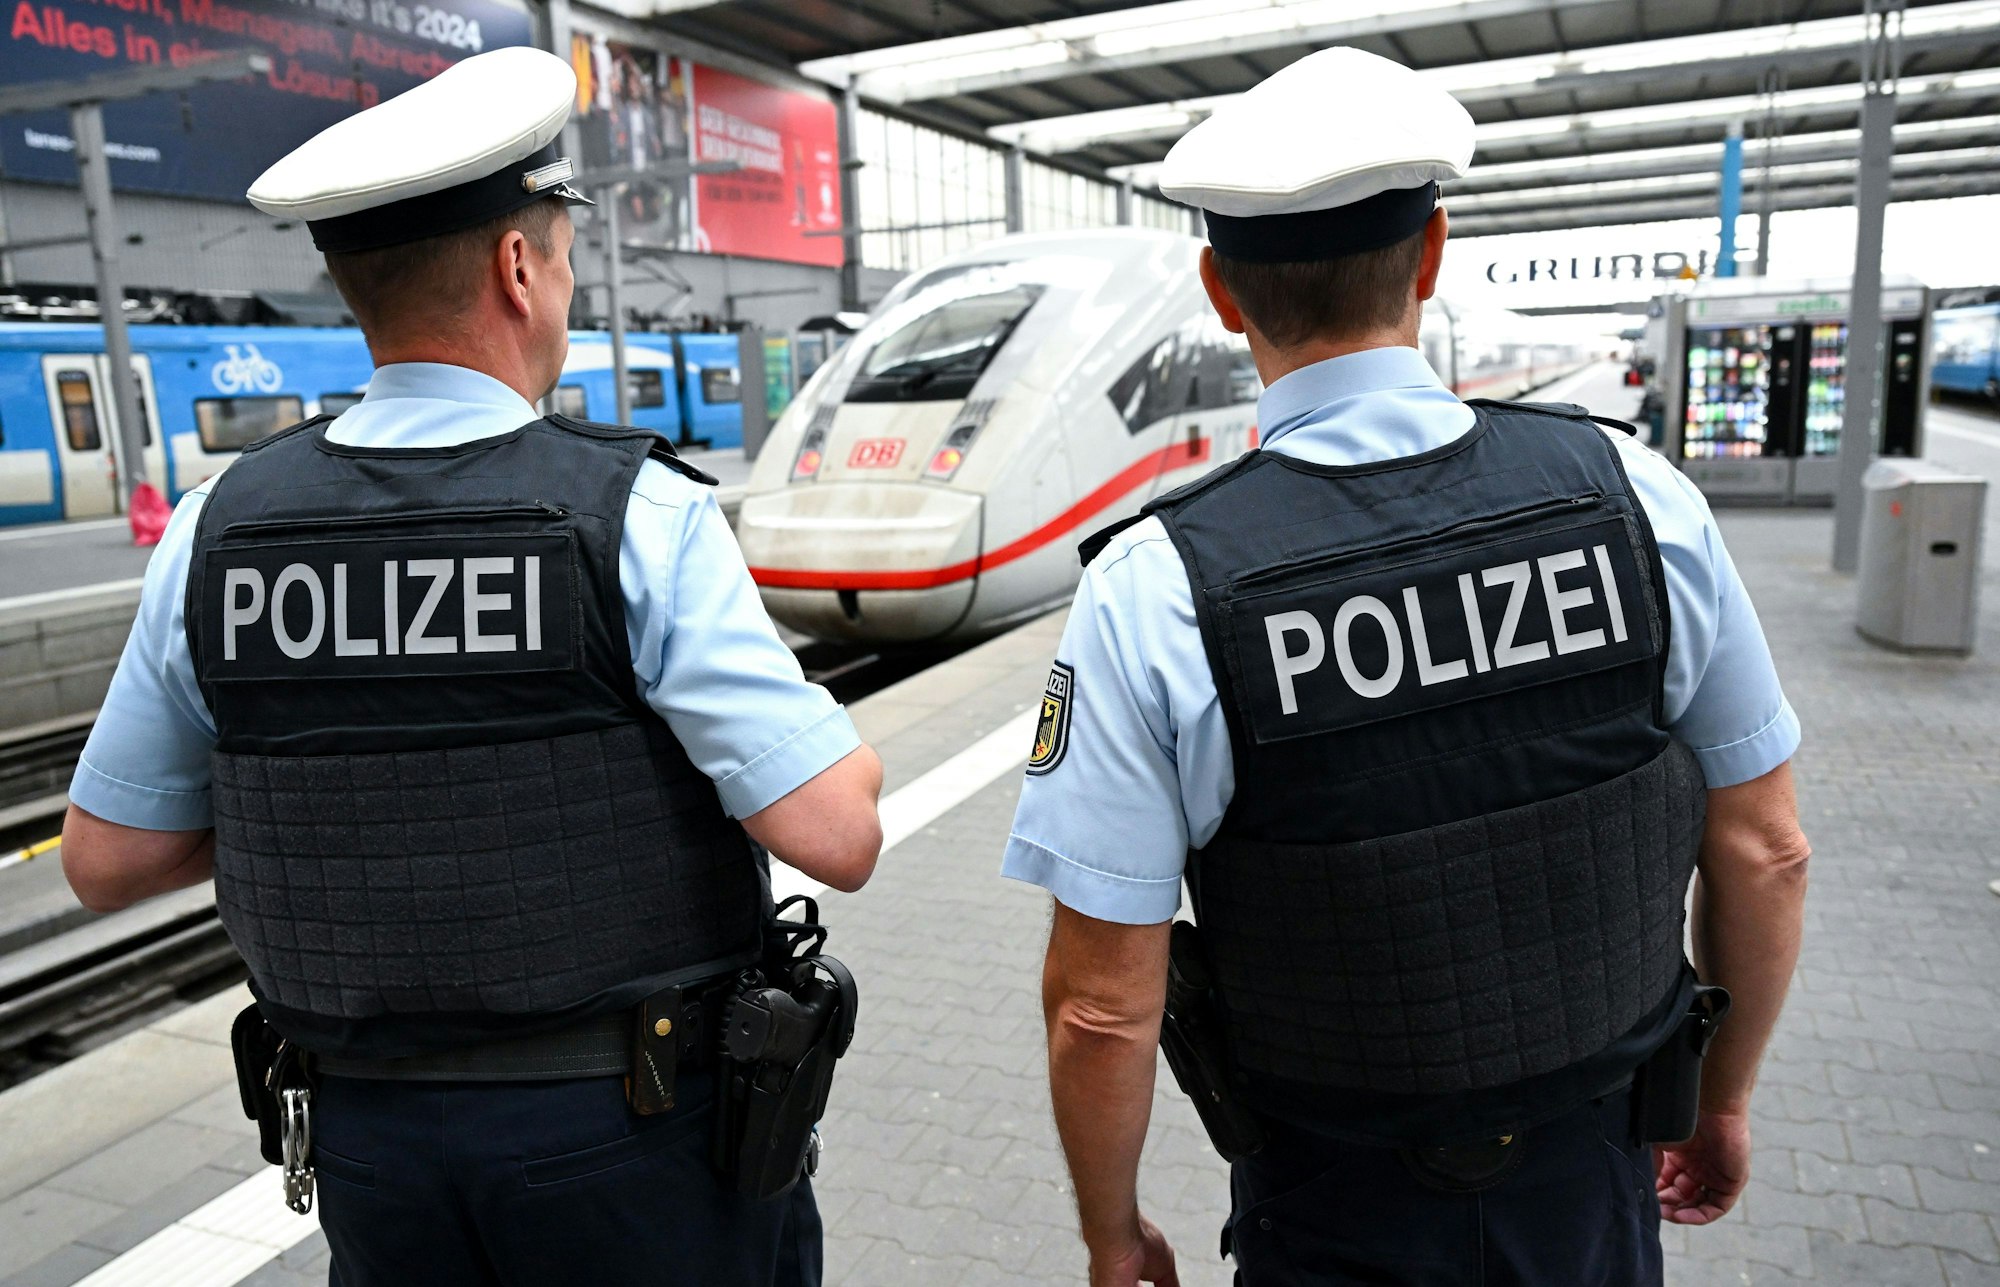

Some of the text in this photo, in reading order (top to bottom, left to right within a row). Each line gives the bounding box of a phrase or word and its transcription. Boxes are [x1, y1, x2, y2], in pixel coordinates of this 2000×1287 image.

[10, 1, 118, 58] Alles
[123, 23, 162, 66] in
[413, 4, 484, 53] 2024
[1486, 248, 1716, 284] GRUNDI
[223, 555, 542, 661] POLIZEI
[1263, 544, 1629, 716] POLIZEI
[1047, 672, 1067, 698] IZEI
